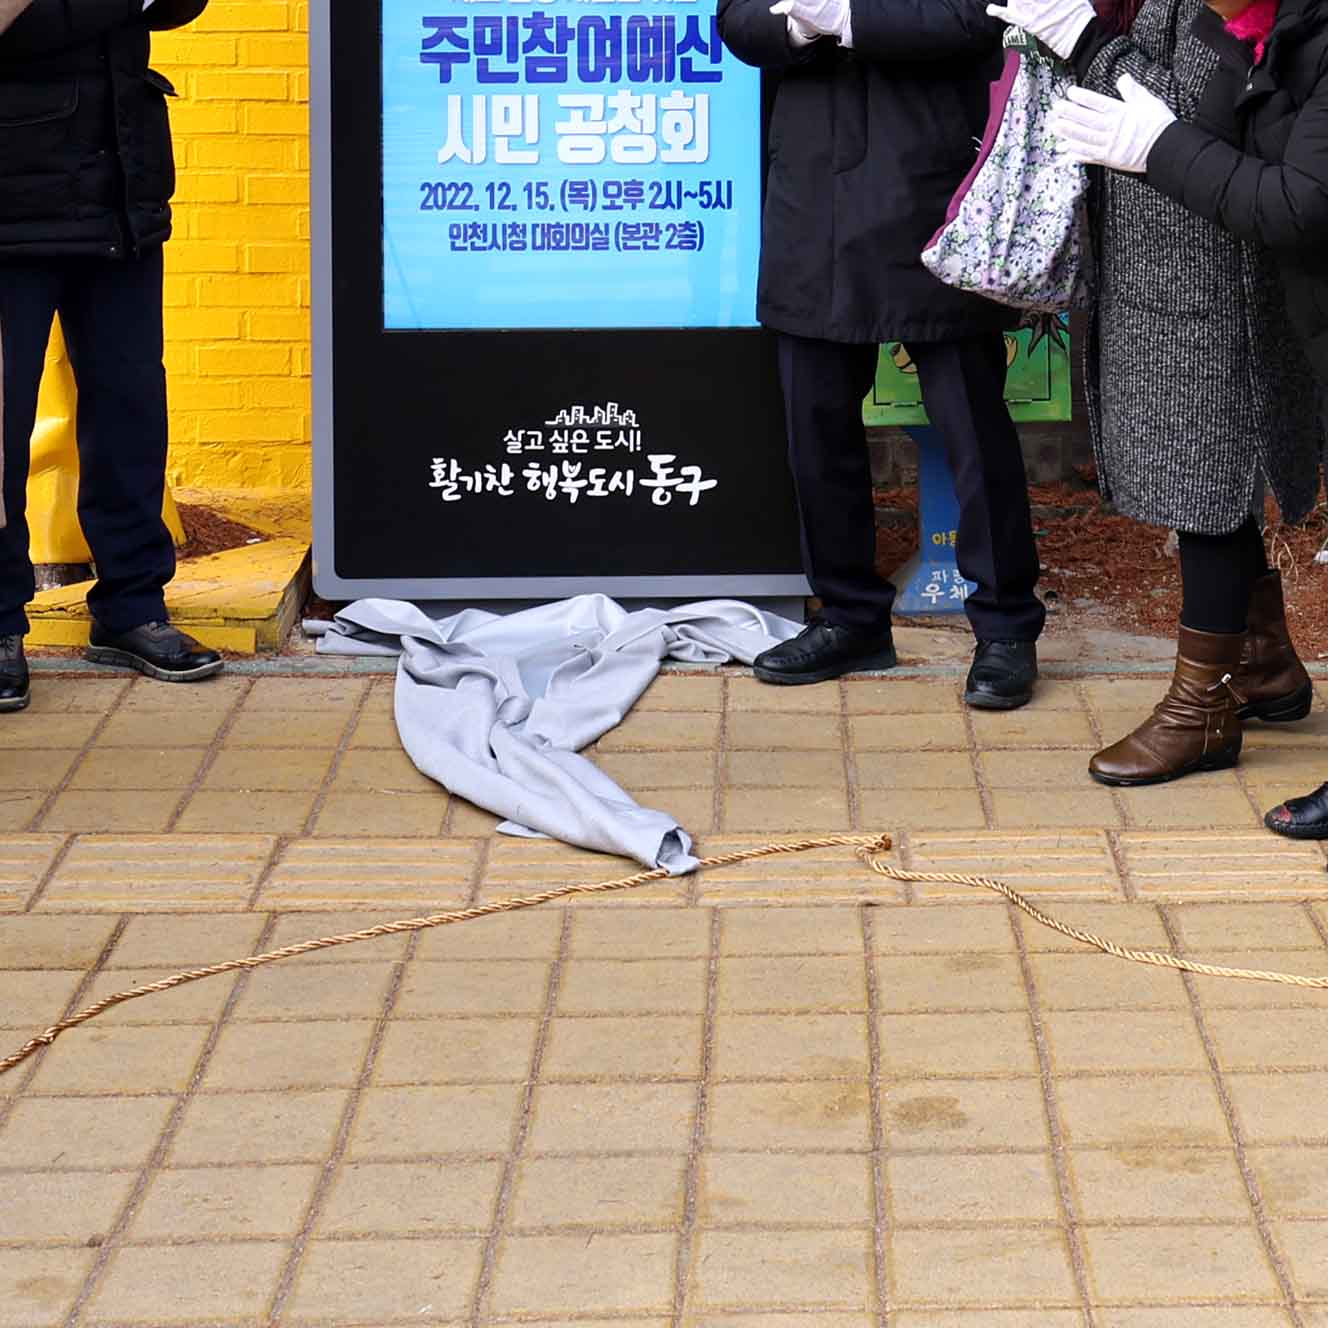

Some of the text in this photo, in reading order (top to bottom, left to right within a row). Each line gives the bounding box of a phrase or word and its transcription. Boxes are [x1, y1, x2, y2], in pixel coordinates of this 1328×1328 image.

[420, 12, 723, 83] 주민참여예산
[437, 90, 710, 164] 시민 공청회
[420, 180, 732, 212] 2022. 12. 15. (목) 오후 2시~5시
[448, 221, 704, 251] 인천시청 대회의실 (본관 2층)
[503, 429, 642, 454] 살고 싶은 도시!
[428, 454, 717, 506] 활기찬 행복도시 동구
